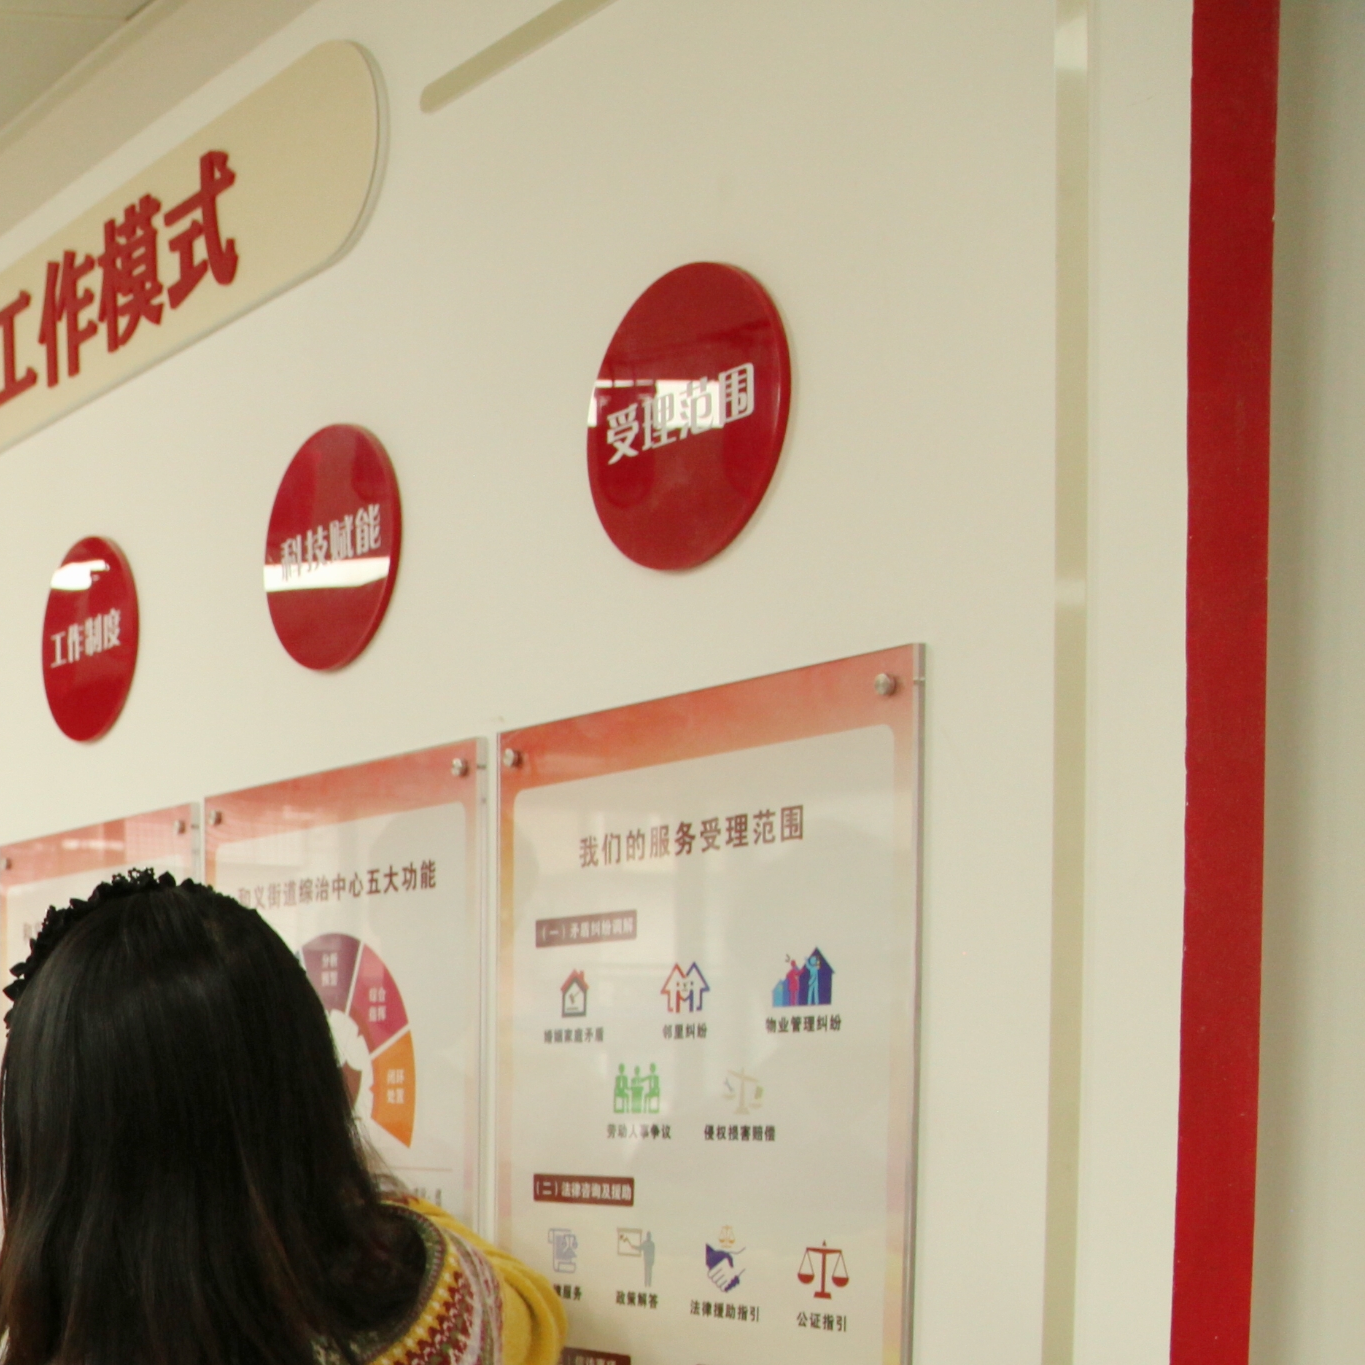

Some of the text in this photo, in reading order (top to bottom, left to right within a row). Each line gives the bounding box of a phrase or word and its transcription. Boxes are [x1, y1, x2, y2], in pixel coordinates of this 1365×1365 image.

[606, 362, 755, 465] 受理范围
[280, 503, 382, 582] 科技赋能
[50, 607, 122, 668] 工作制度
[579, 804, 804, 869] 我们的服务受理范围
[765, 1013, 842, 1034] 物业管理纠纷
[703, 1124, 777, 1142] 侵权损害赔偿
[690, 1299, 761, 1322] 法律援助指引
[796, 1311, 848, 1332] 公证指引
